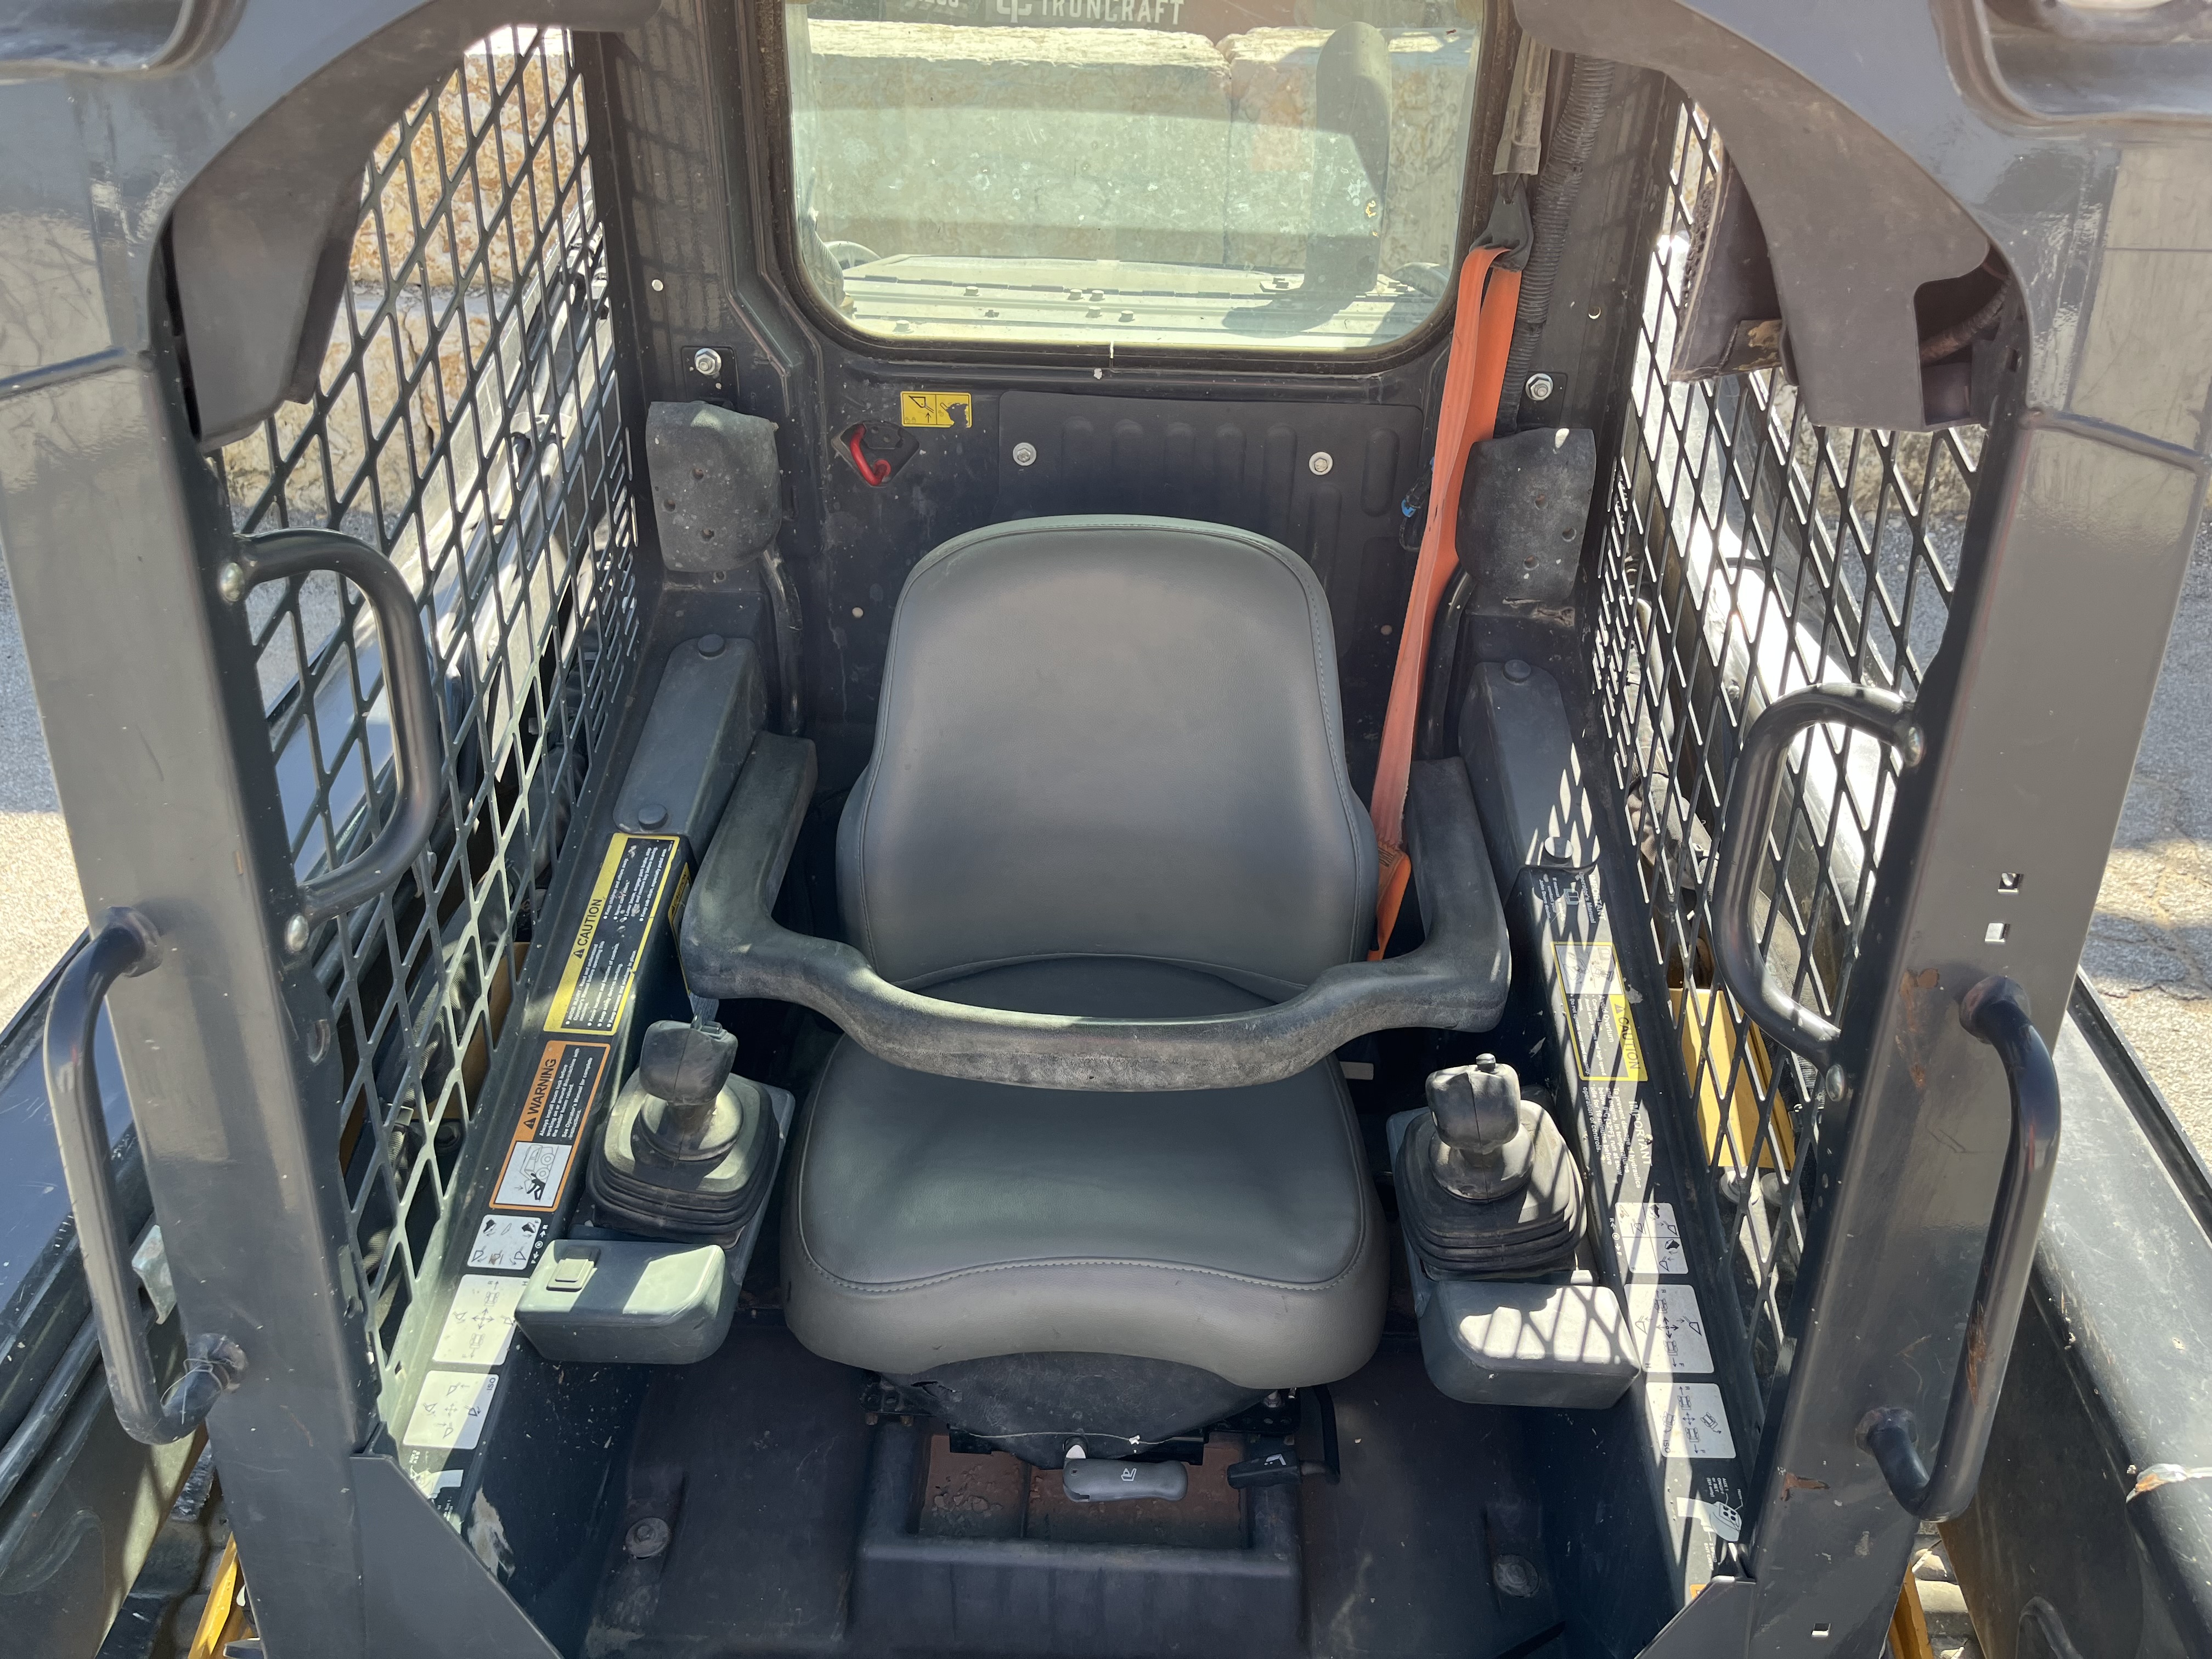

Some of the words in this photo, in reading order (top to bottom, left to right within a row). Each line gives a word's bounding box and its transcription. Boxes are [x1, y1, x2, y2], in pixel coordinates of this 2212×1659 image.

[1042, 0, 1184, 25] IRONCRAFT
[1577, 871, 1591, 900] Operator's
[1585, 902, 1596, 923] Manual
[1588, 874, 1606, 920] IMPORTANT
[576, 899, 602, 946] CAUTION
[1591, 998, 1599, 1011] Carry
[1598, 995, 1609, 1013] Avoid
[1602, 1014, 1615, 1042] Overturn
[1595, 1050, 1603, 1060] high
[1617, 1017, 1641, 1069] CAUTION
[527, 1058, 557, 1114] WARNING
[1598, 1061, 1606, 1075] speed
[538, 1119, 550, 1136] Always
[545, 1104, 554, 1118] install
[550, 1090, 559, 1103] boom
[558, 1064, 568, 1079] before
[545, 1117, 557, 1136] working
[556, 1087, 566, 1103] around
[554, 1113, 564, 1128] loader
[560, 1099, 569, 1113] boom
[561, 1128, 569, 1137] See
[565, 1103, 578, 1127] Operator's
[573, 1086, 583, 1102] Manual
[582, 1057, 594, 1077] complete
[1581, 1087, 1594, 1115] operation
[1590, 1125, 1602, 1152] controls.
[1597, 1087, 1606, 1104] below
[1613, 1160, 1623, 1175] slow
[1597, 1119, 1608, 1142] minutes
[1603, 1144, 1613, 1164] before
[1606, 1100, 1618, 1122] engine,
[1614, 1131, 1630, 1173] temperatures
[1613, 1096, 1626, 1119] prevent
[1620, 1121, 1632, 1144] damage
[1627, 1154, 1643, 1188] hydraulics
[1628, 1101, 1653, 1166] IMPORTANT
[487, 1378, 496, 1391] ISO
